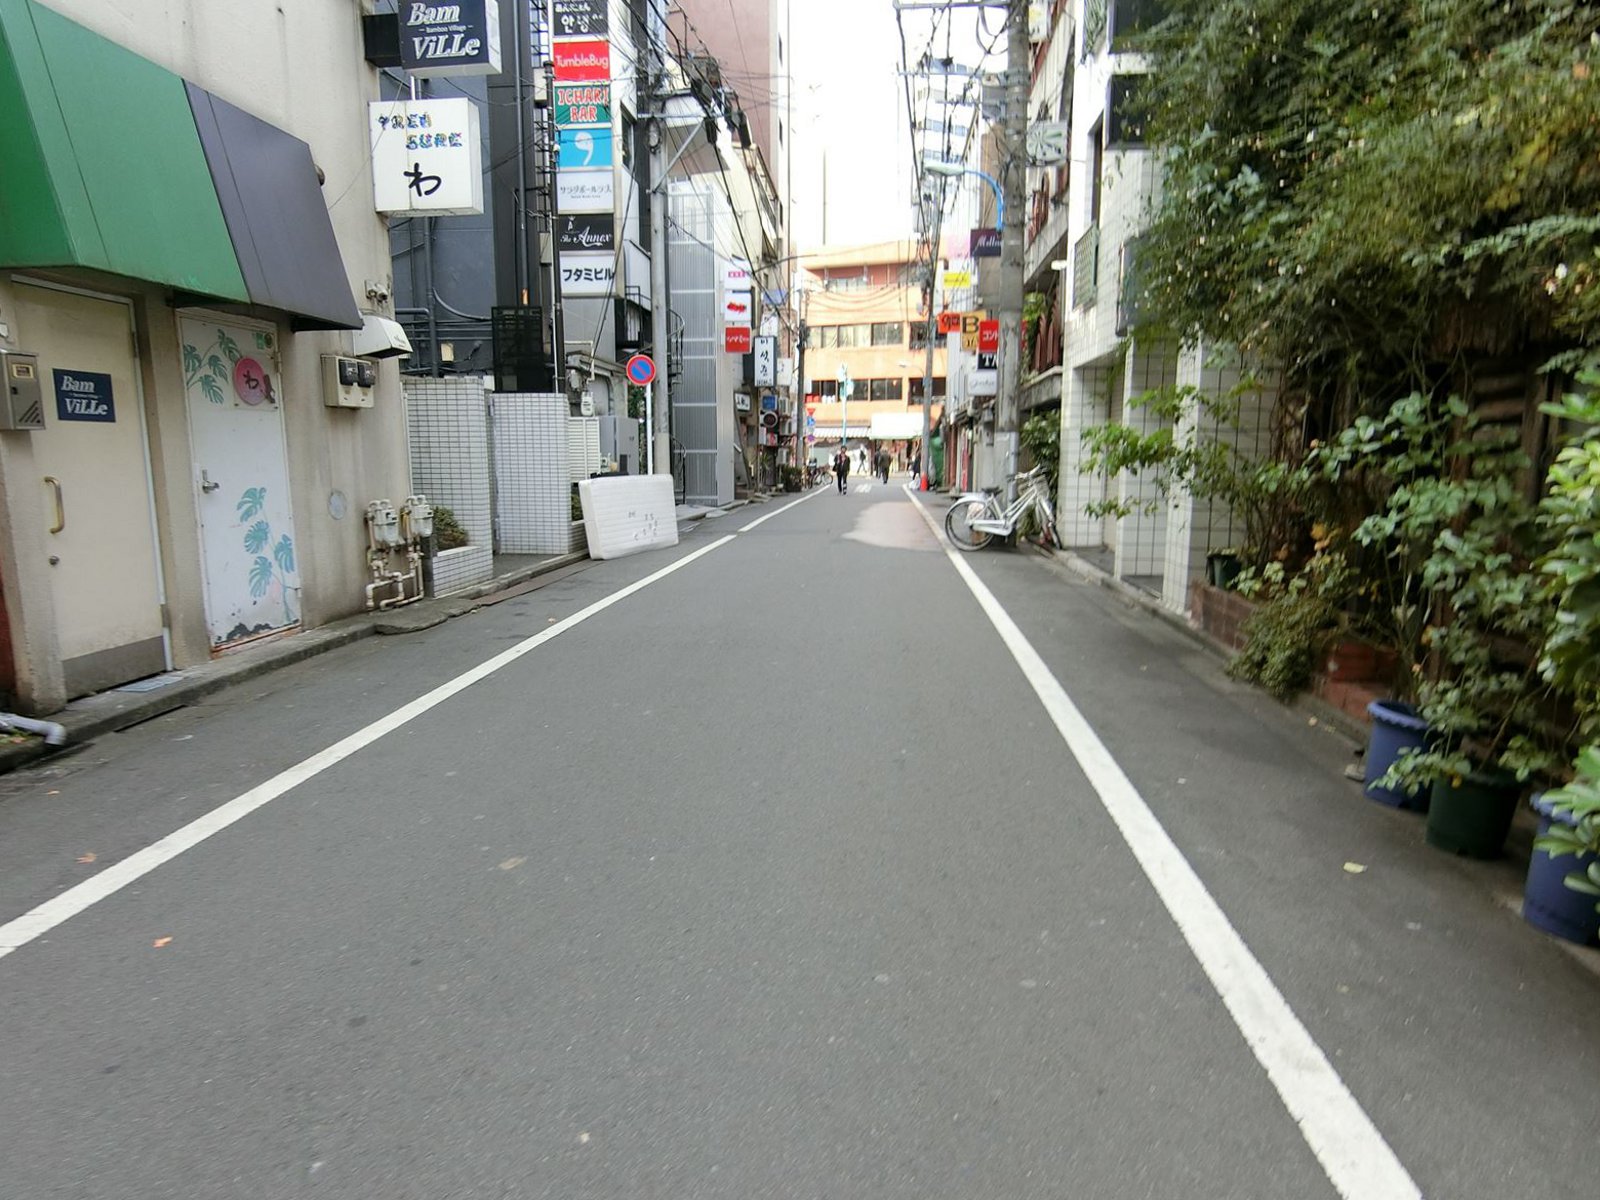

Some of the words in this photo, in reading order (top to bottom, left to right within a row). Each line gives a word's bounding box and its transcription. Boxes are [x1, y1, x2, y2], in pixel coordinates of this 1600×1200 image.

[407, 2, 460, 26] Bam
[412, 33, 480, 60] ViLLe
[555, 54, 608, 69] TumbleBug
[570, 105, 597, 122] BAR
[403, 162, 442, 197] わ
[562, 268, 614, 283] フタミビル
[61, 375, 95, 393] Bam
[243, 369, 260, 390] わ
[64, 398, 108, 415] ViLLe
